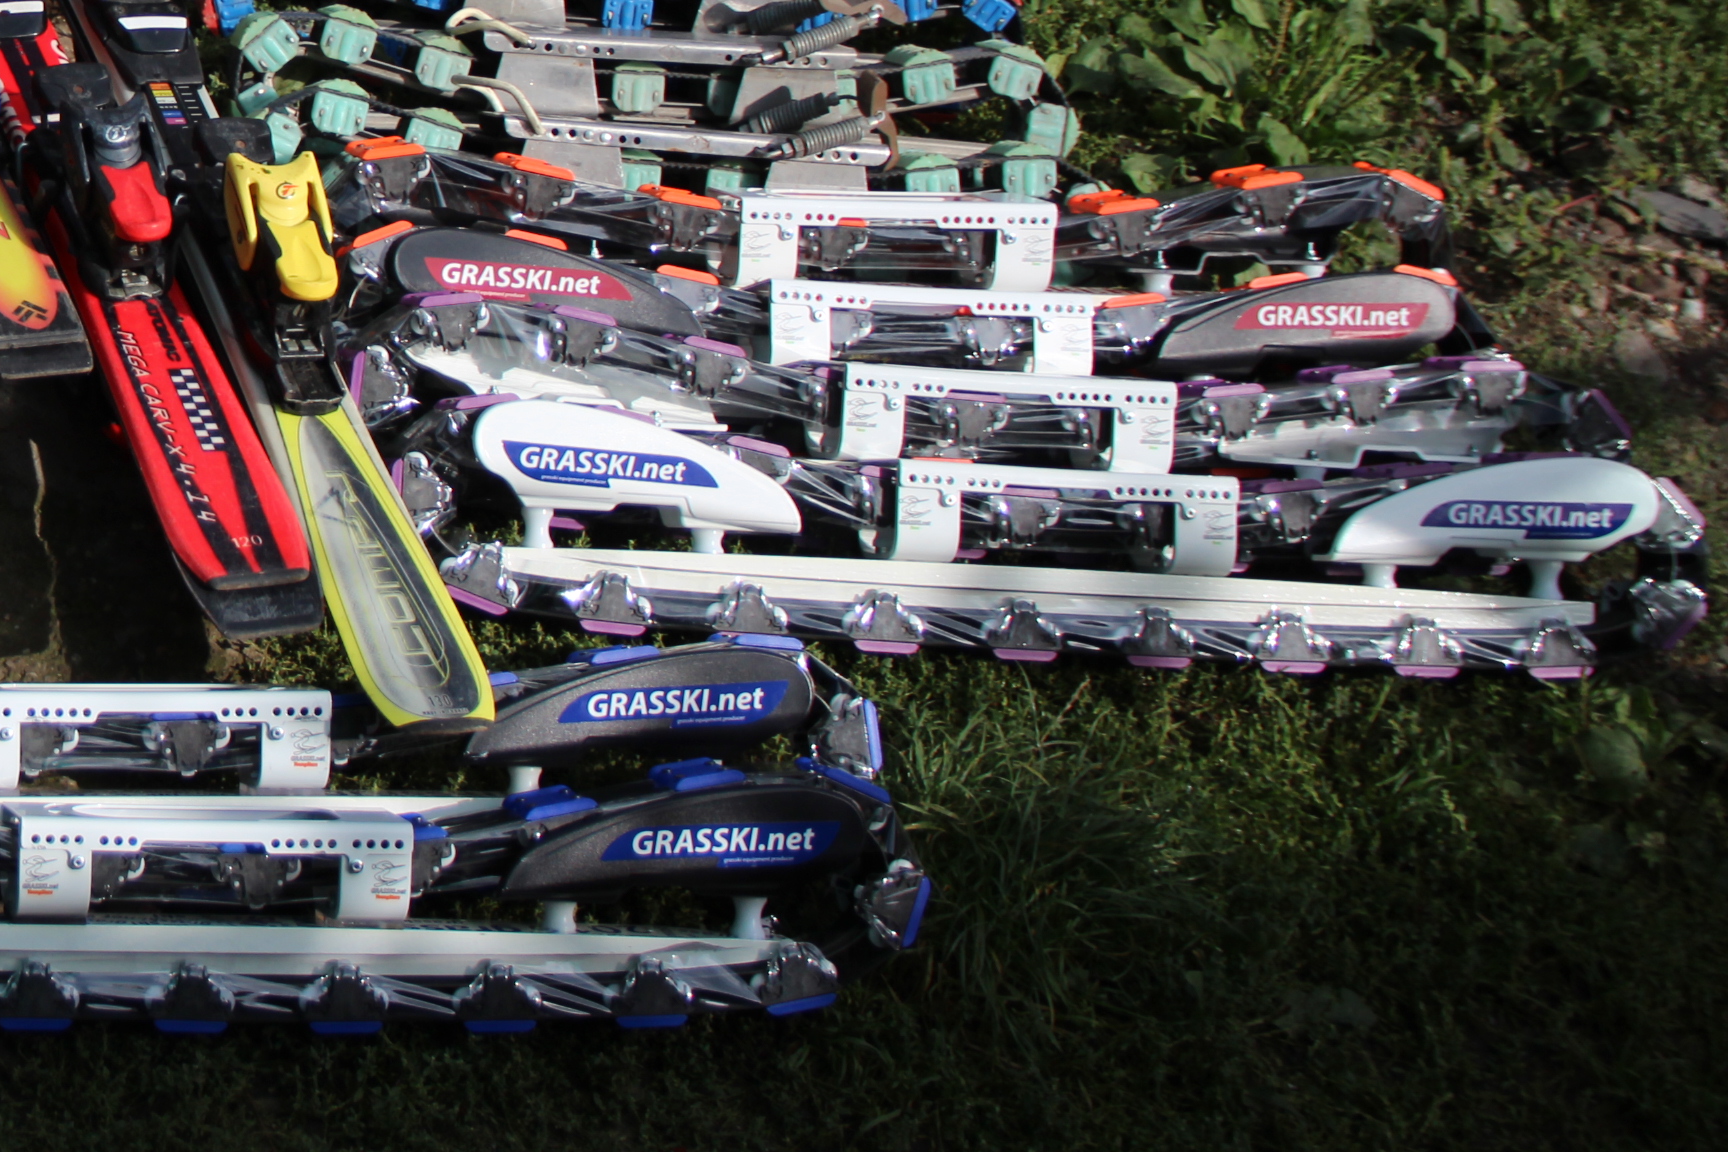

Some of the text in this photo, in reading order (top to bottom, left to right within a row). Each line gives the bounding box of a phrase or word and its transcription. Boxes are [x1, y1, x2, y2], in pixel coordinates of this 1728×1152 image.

[442, 262, 601, 295] GRASSKI.net
[1257, 305, 1410, 327] GRASSKI.net
[117, 330, 149, 378] MEGA
[140, 382, 186, 457] CARV-X
[519, 446, 687, 482] GRASSKI.net
[1447, 504, 1613, 528] GRASSKI.net
[231, 535, 264, 549] 120
[427, 694, 451, 708] 130
[587, 687, 764, 718] GRASSKI.net
[632, 827, 815, 856] GRASSKI.net
